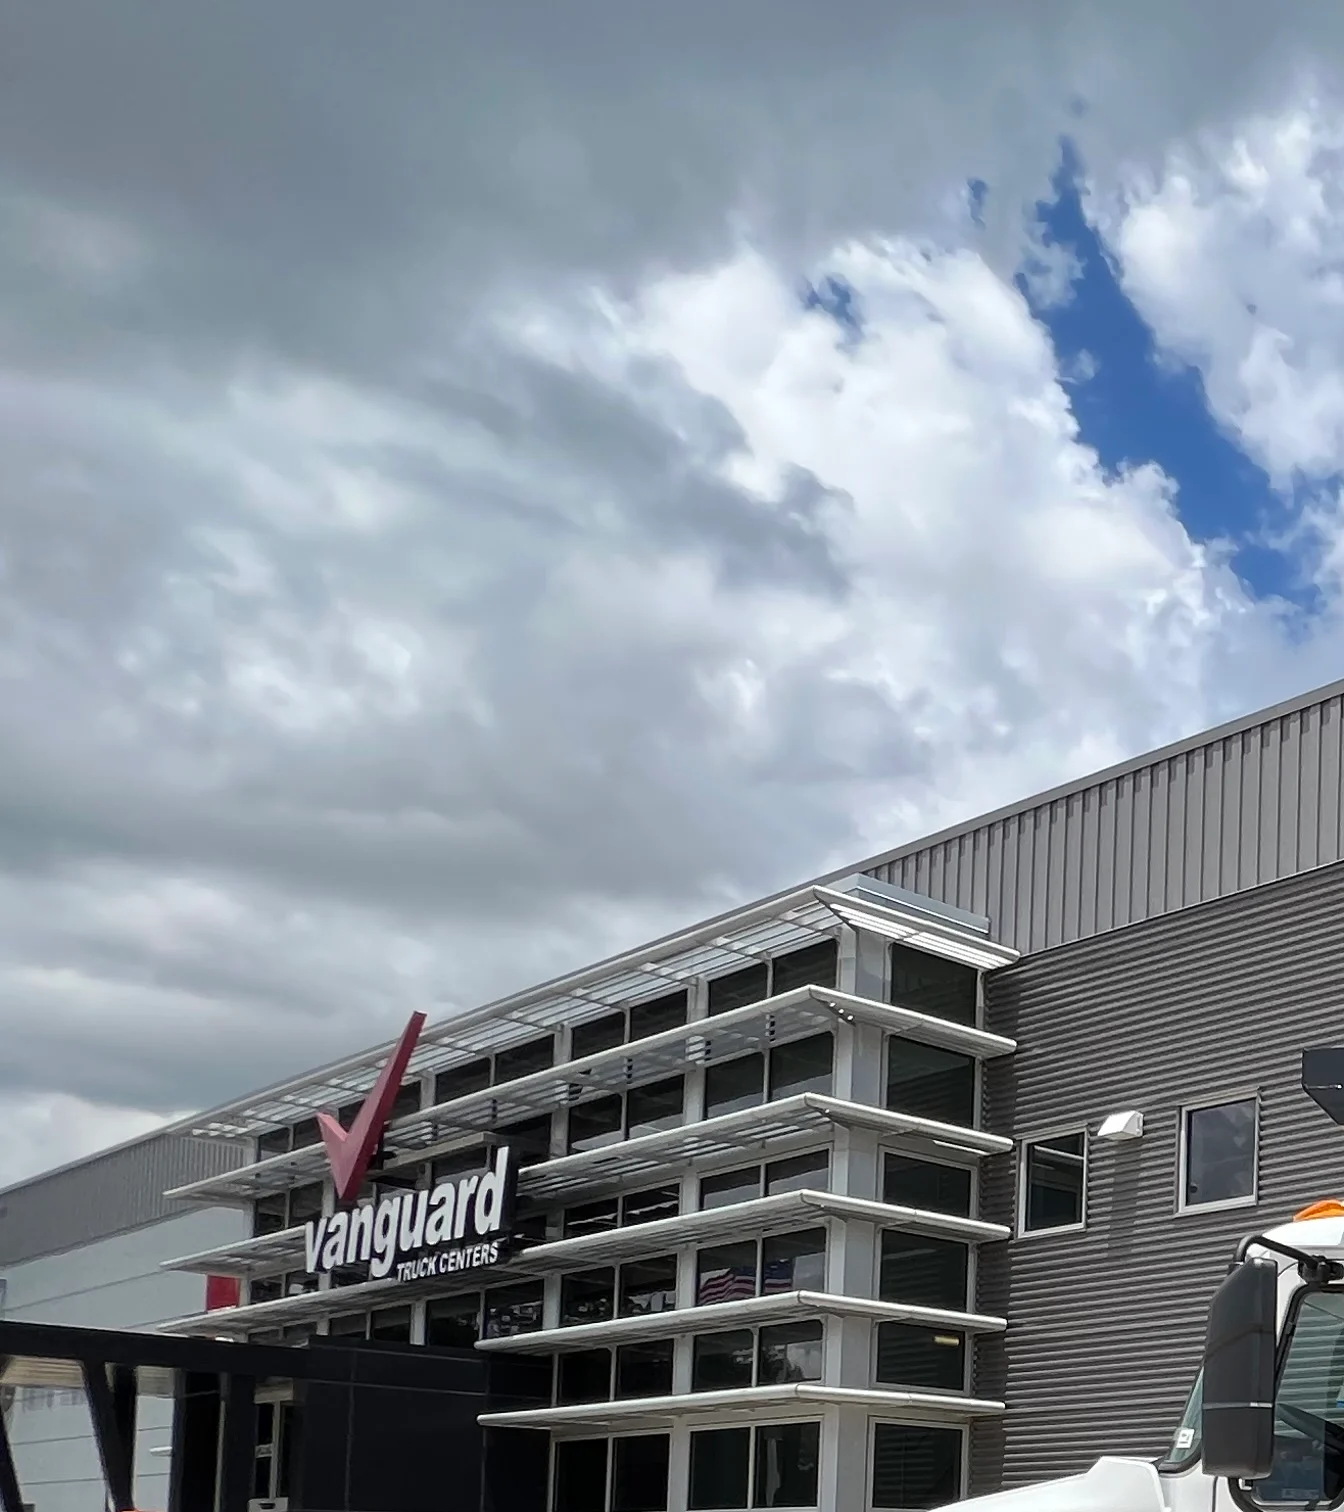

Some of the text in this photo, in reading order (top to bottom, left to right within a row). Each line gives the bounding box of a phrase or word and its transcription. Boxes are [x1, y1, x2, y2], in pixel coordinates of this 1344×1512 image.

[305, 1146, 509, 1278] vanguard
[396, 1241, 499, 1282] TRUCK CENTERS
